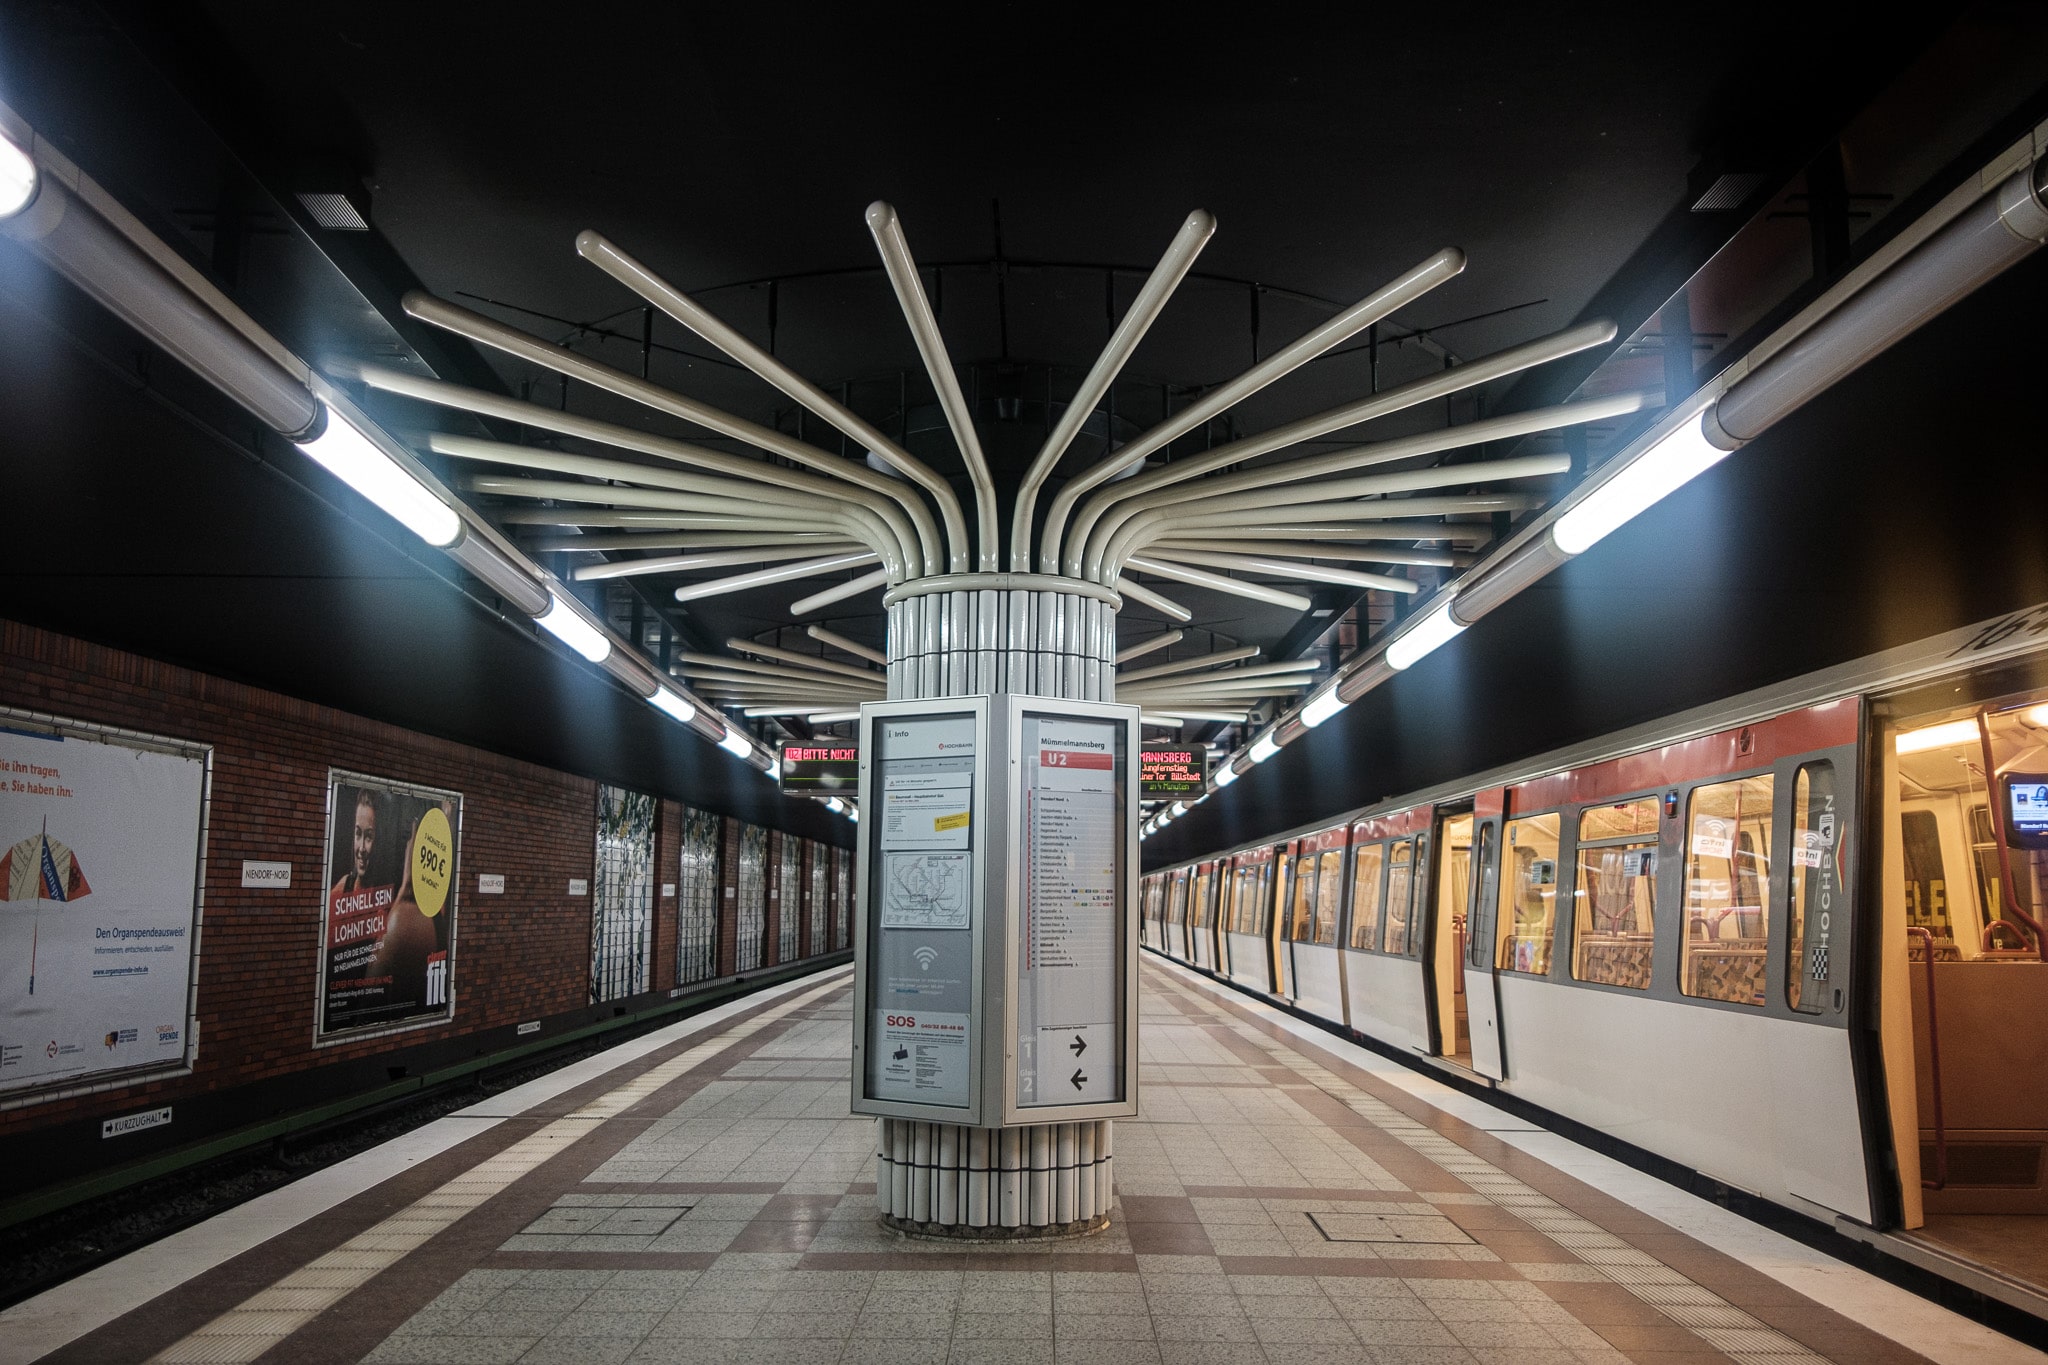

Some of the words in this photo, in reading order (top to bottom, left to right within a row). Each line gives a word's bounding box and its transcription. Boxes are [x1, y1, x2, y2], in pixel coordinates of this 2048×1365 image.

[1041, 738, 1105, 750] Mümmelmannsberg
[803, 749, 828, 760] BITTE
[831, 749, 856, 760] NICHT
[12, 761, 28, 773] ihn
[30, 764, 61, 779] tragen,
[1142, 764, 1188, 773] Jungfernstieg
[1171, 773, 1200, 781] Billstedt
[12, 780, 25, 793] Sie
[27, 782, 54, 795] haben
[56, 785, 74, 798] ihn:
[420, 845, 438, 872] 9,90
[439, 858, 446, 878] €
[245, 869, 290, 880] NIENDORF-NORD
[335, 893, 373, 915] SCHNELL
[375, 888, 392, 907] SEIN
[95, 927, 111, 939] Den
[112, 926, 185, 941] Organspendeausweis!
[334, 920, 365, 943] LOHNT
[426, 960, 447, 1006] fit
[887, 1015, 916, 1028] SOS
[159, 1031, 179, 1041] SPENDE
[1025, 1043, 1032, 1058] 1
[1023, 1077, 1033, 1093] 2
[114, 1112, 161, 1132] KURZZUGHALT
